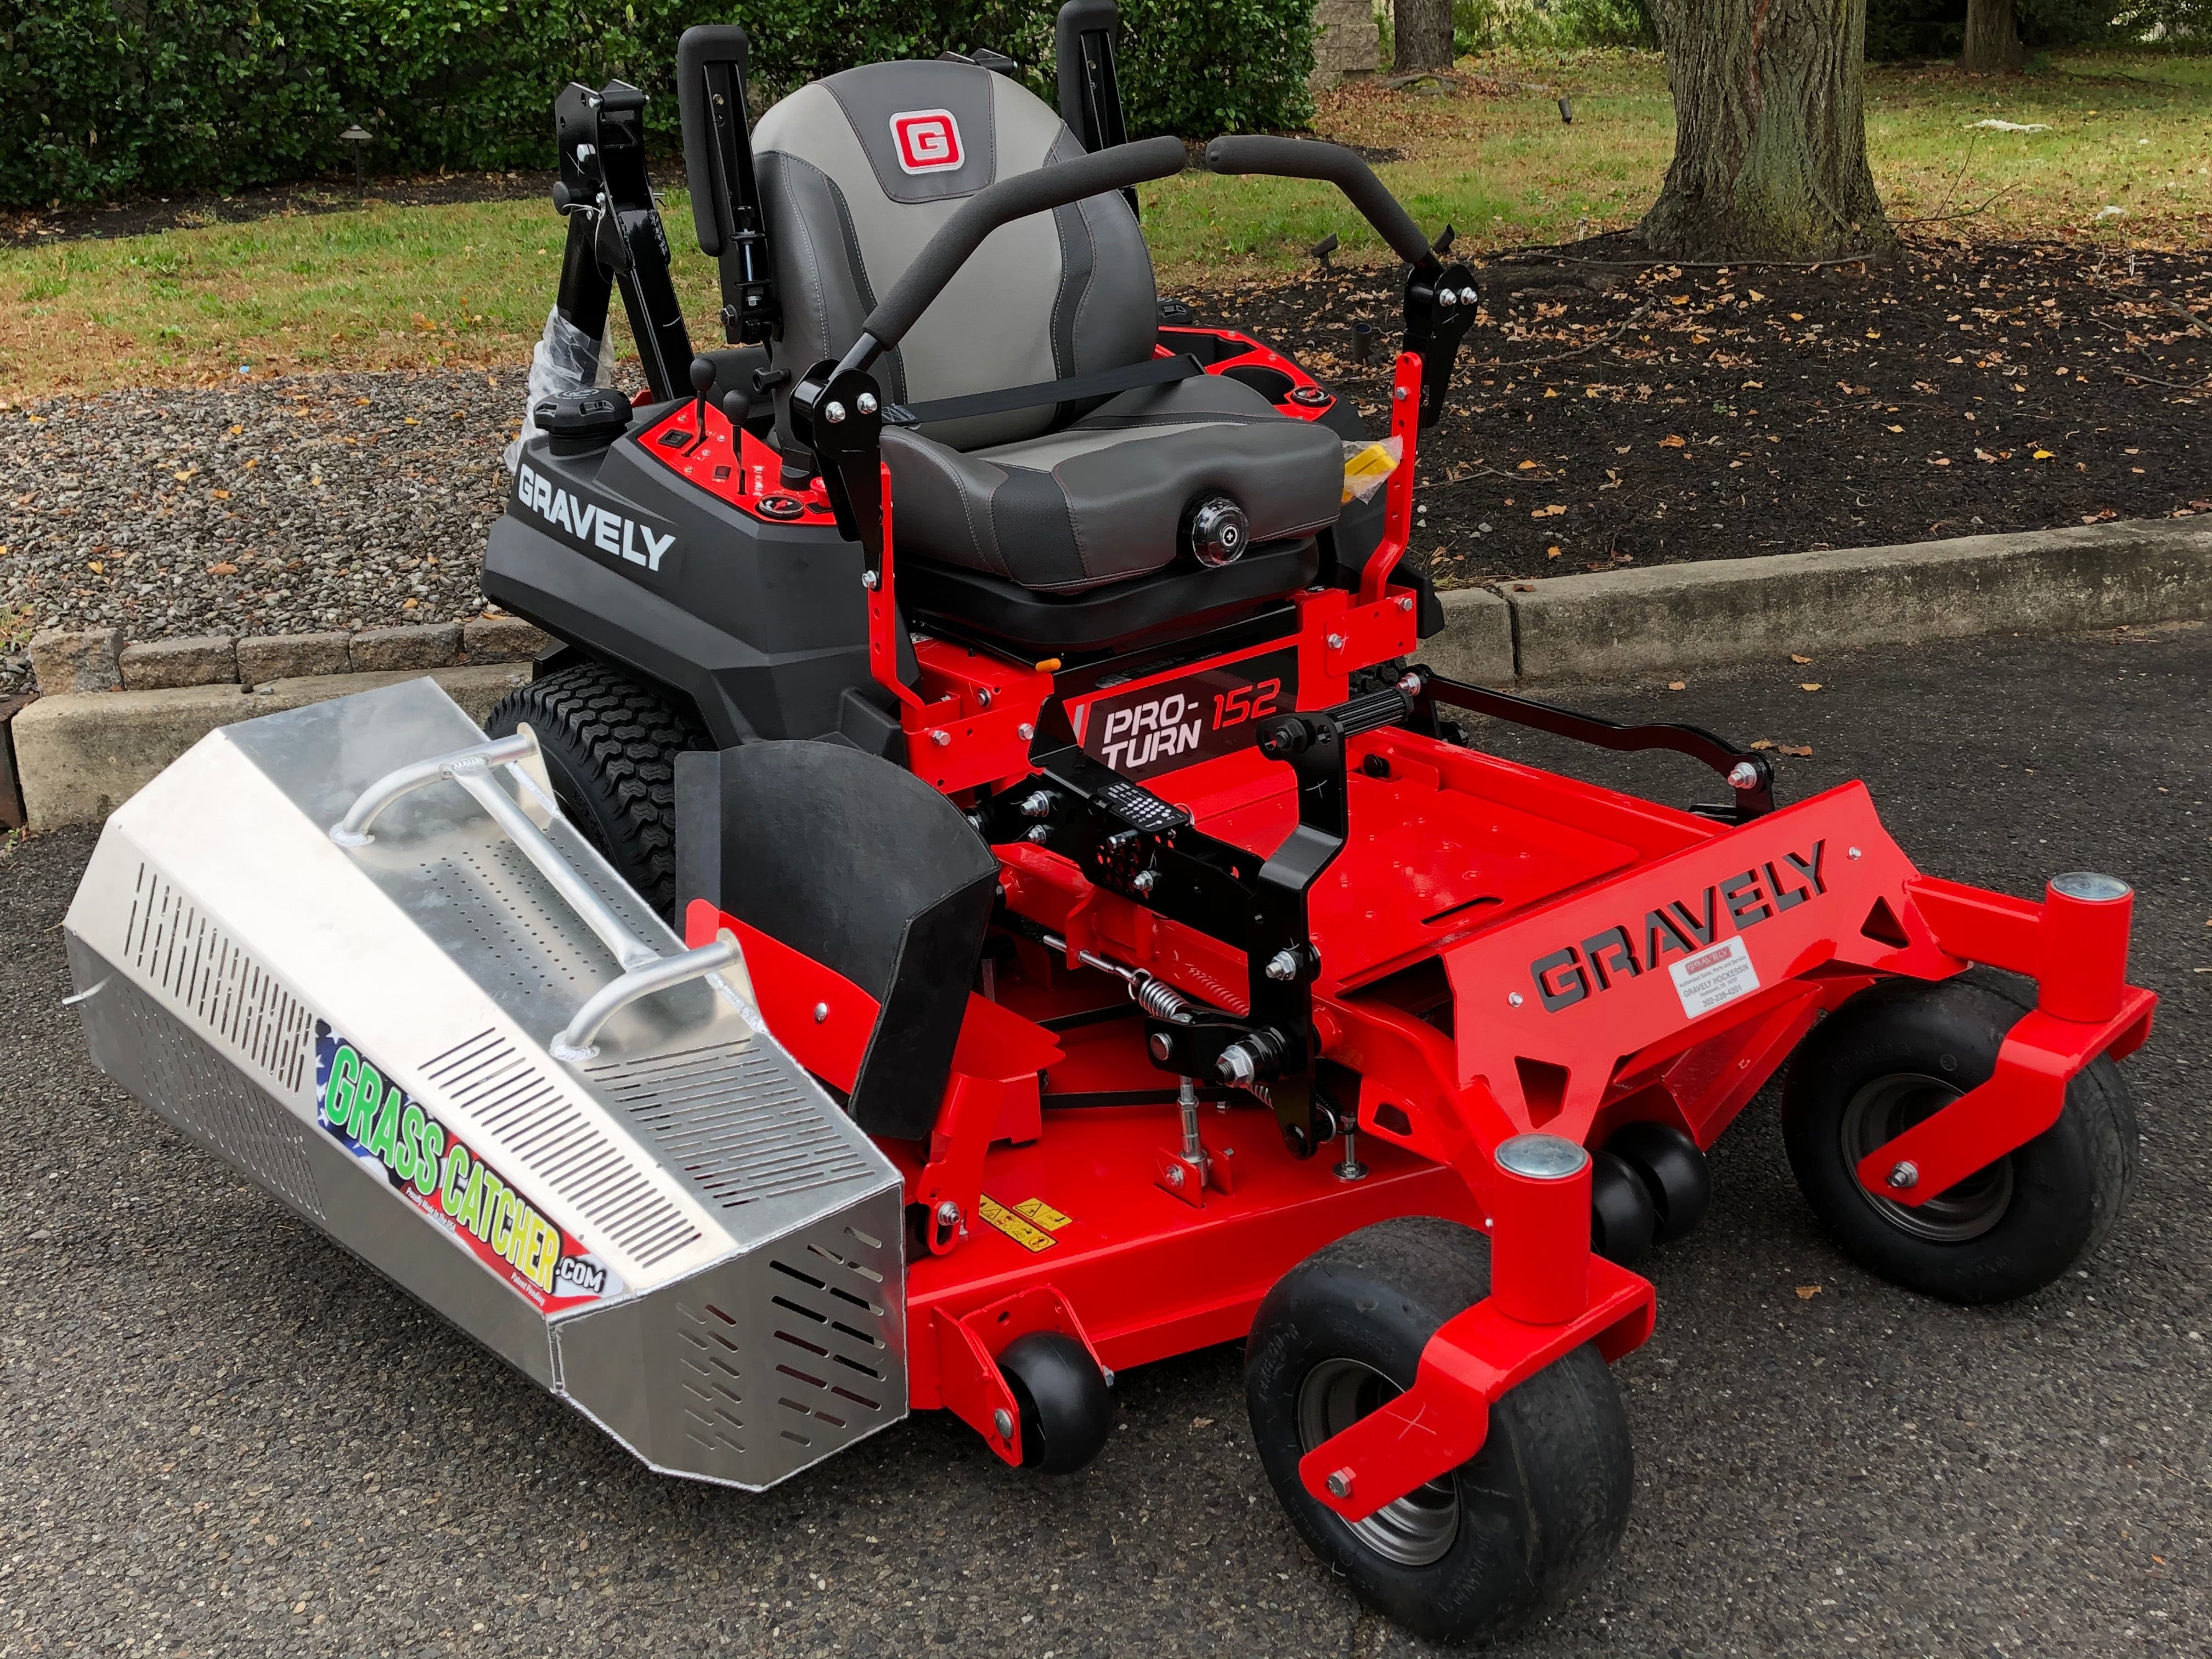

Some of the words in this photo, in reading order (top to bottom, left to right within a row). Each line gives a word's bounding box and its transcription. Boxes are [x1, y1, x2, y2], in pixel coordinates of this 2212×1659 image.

[906, 121, 950, 161] G
[518, 463, 676, 572] GRAVELY
[1103, 693, 1199, 744] PRO-
[1212, 678, 1281, 730] 152
[1101, 719, 1203, 770] TURN
[1530, 838, 1827, 1013] GRAVELY
[1683, 979, 1712, 997] GRAVELY
[1712, 963, 1749, 985] HOCKESSIN
[1687, 948, 1728, 972] GRAVELY
[1702, 984, 1743, 1008] 302-239-4201
[324, 1045, 444, 1195] GRASS
[441, 1144, 561, 1294] CATCHER
[405, 1187, 422, 1206] Proudly
[510, 1272, 527, 1290] Patent
[526, 1283, 545, 1307] Pending
